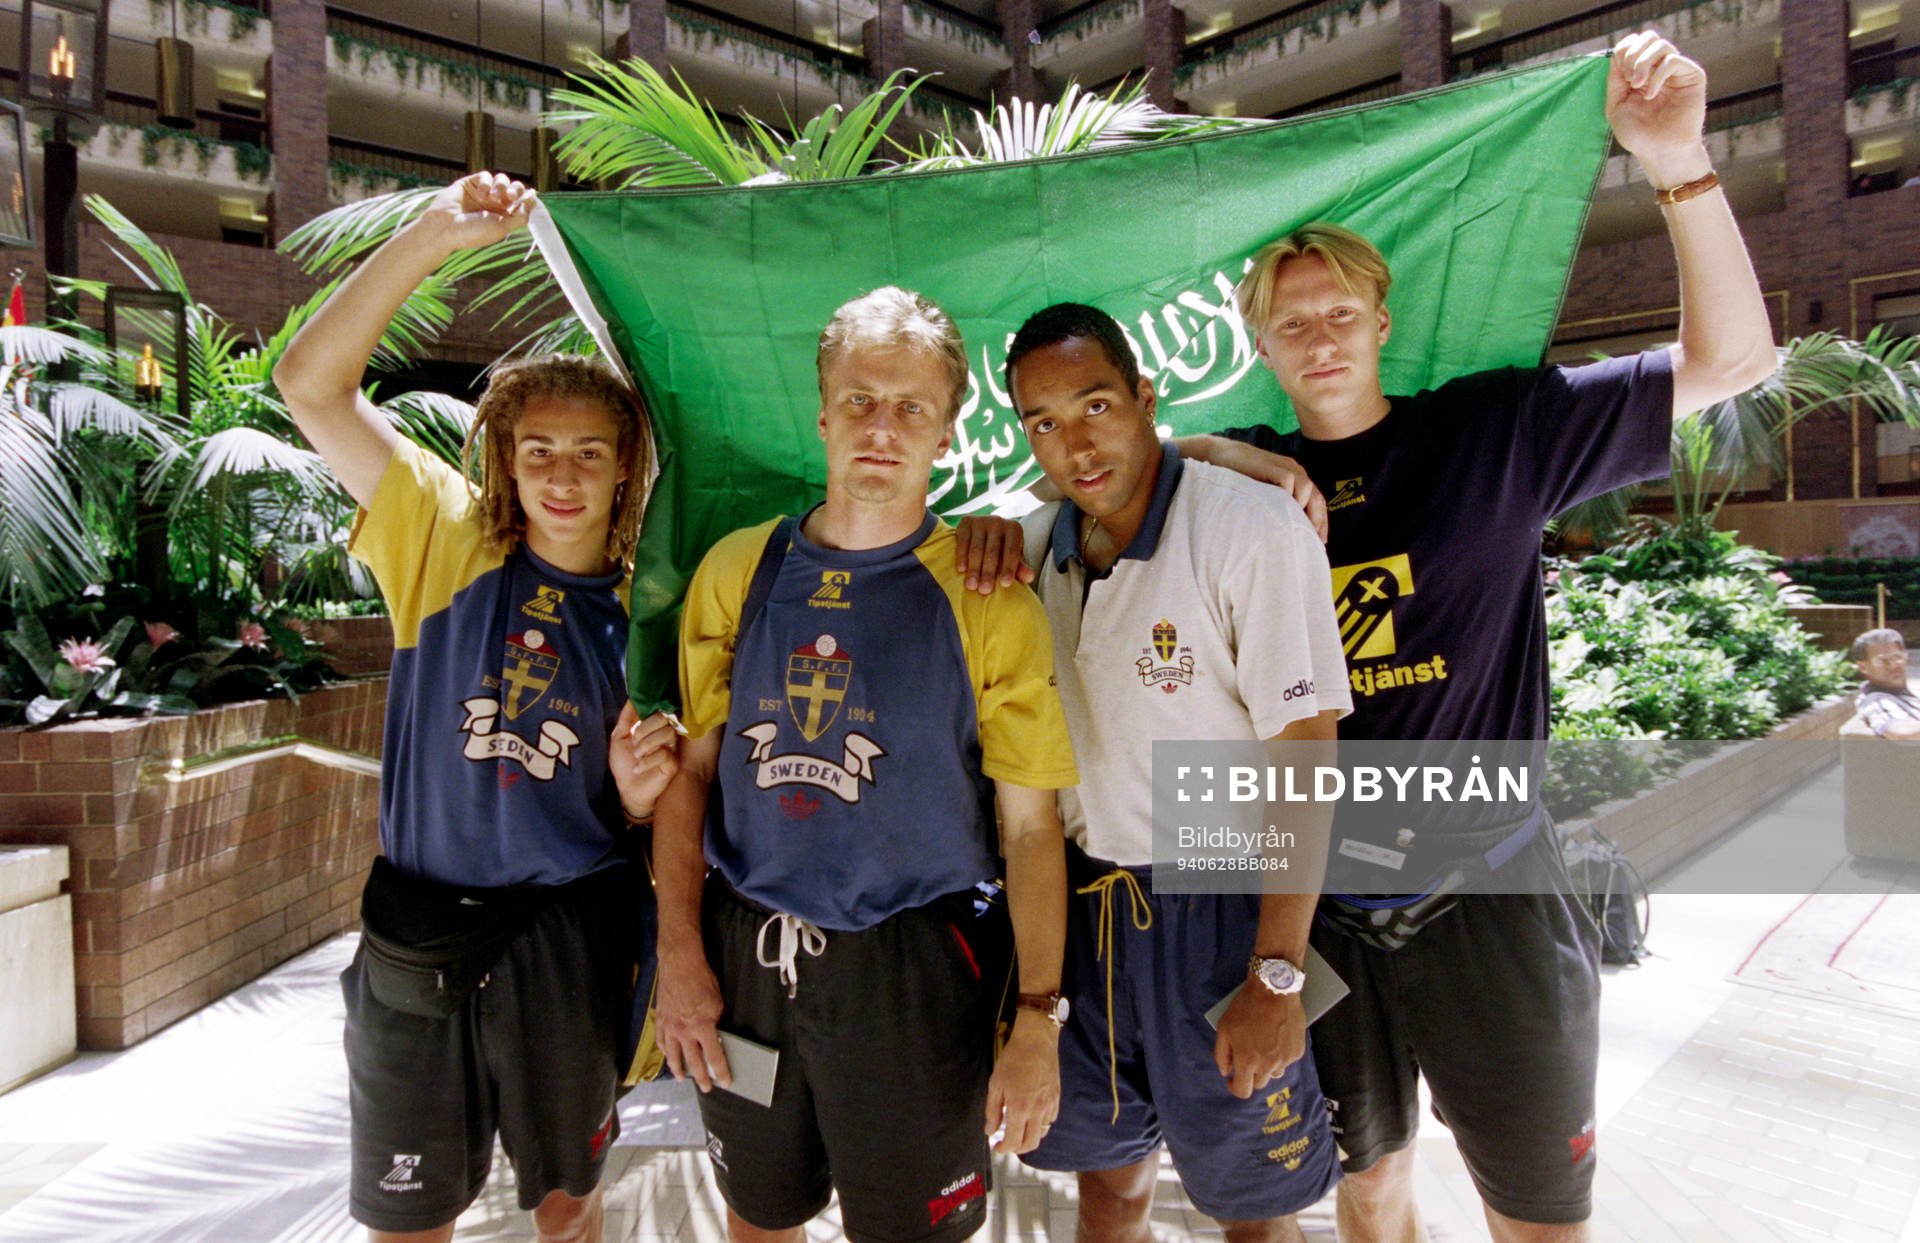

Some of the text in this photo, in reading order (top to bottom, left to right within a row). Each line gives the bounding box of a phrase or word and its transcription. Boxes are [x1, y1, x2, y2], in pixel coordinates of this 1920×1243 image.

[548, 698, 580, 717] 1904
[759, 698, 876, 723] EST 1904
[769, 762, 843, 787] SWEDEN
[1268, 1136, 1309, 1160] adidas
[940, 1171, 976, 1196] adidas
